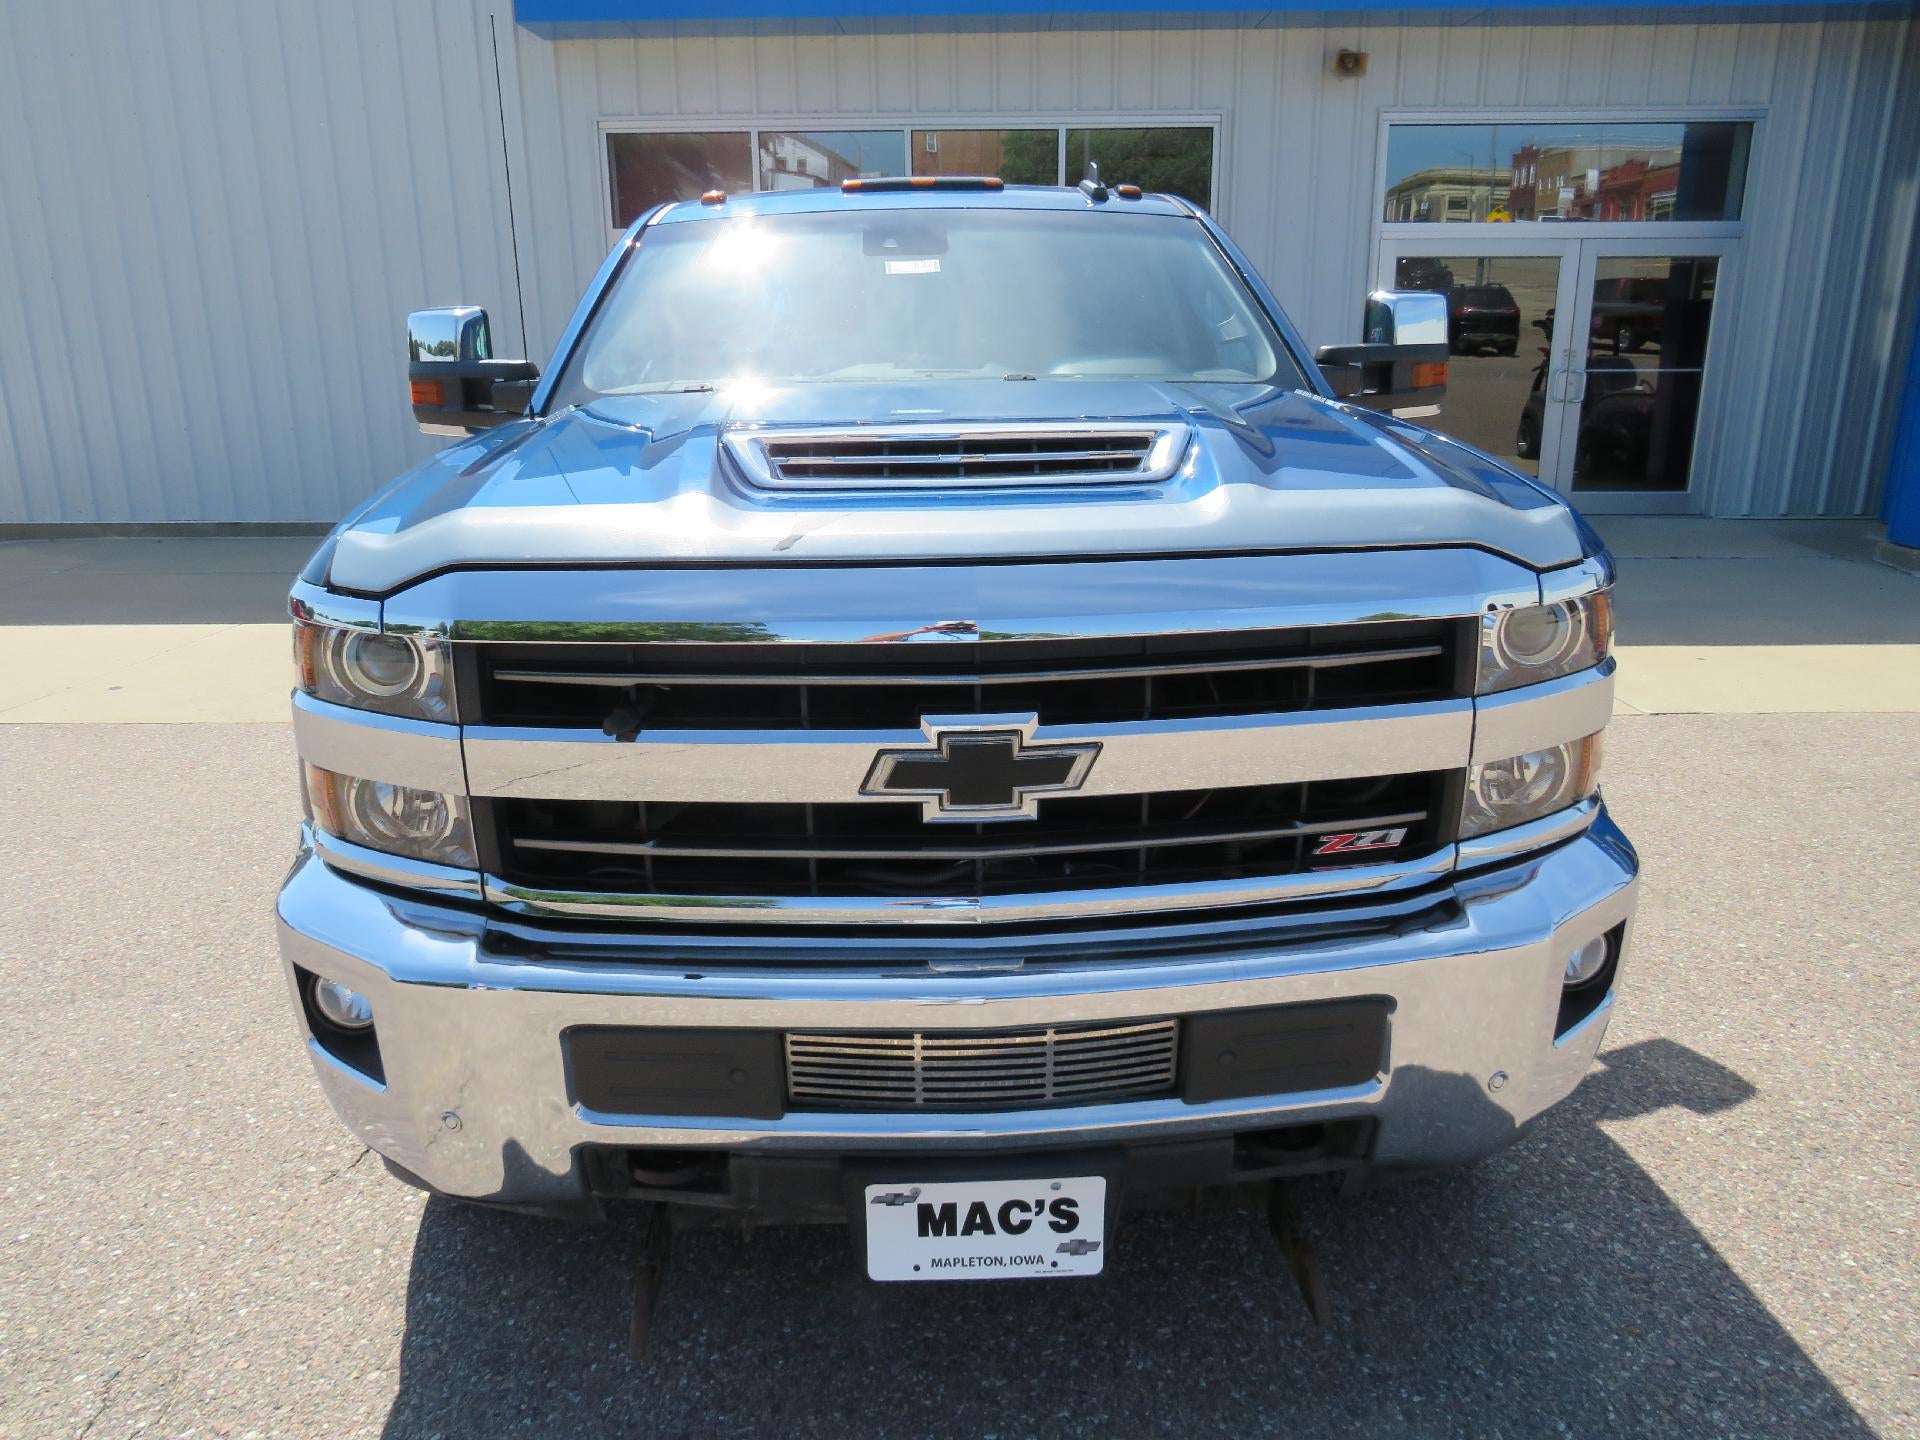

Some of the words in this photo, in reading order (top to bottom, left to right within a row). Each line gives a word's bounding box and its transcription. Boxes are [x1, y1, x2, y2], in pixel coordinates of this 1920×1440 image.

[1312, 828, 1408, 854] Z71
[917, 1197, 1080, 1237] MAC'S
[931, 1256, 1007, 1268] MAPLETON,
[1009, 1254, 1045, 1266] IOWA
